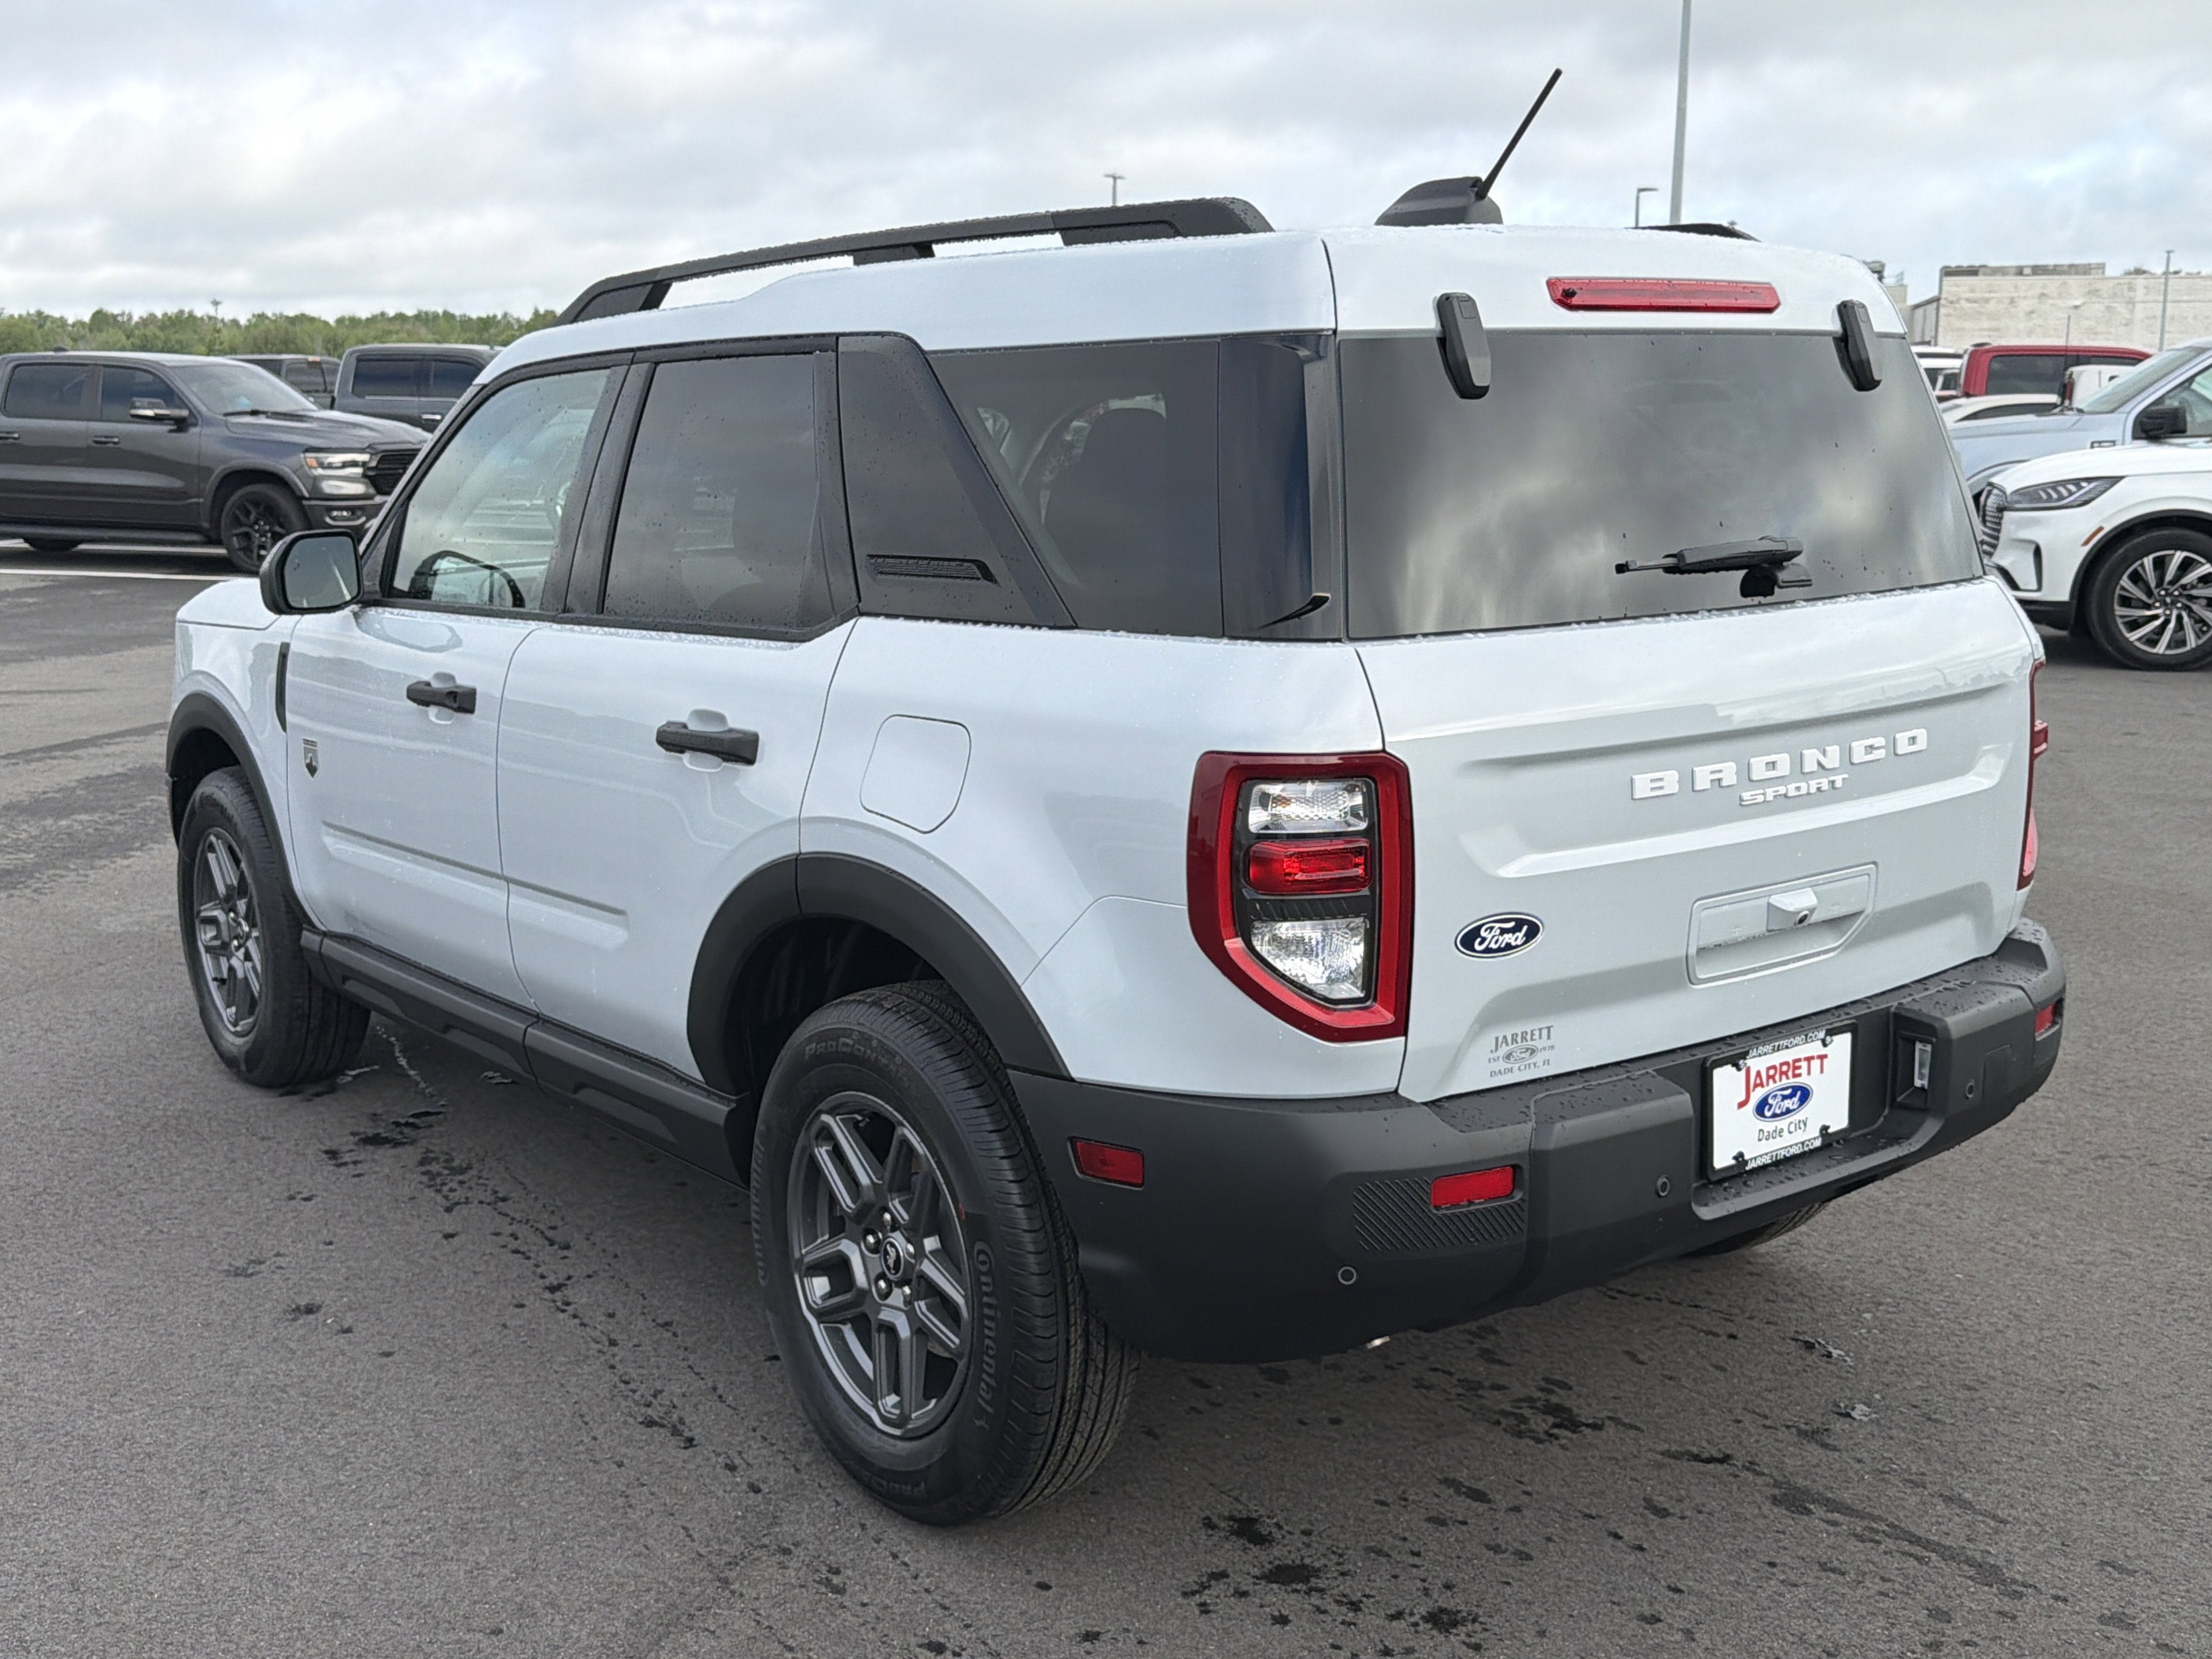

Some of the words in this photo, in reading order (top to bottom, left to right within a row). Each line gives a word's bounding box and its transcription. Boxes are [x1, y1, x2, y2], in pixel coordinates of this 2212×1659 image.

[1632, 728, 1927, 799] BRONCO
[1740, 774, 1848, 806] SPORT
[1474, 922, 1528, 951] Ford
[1490, 1025, 1554, 1054] JARRETT
[1746, 1030, 1826, 1059] JARRETTFORD.COM
[1488, 1056, 1500, 1064] EST
[1490, 1065, 1515, 1077] DADE
[1737, 1054, 1828, 1110] JARRETT
[1764, 1088, 1801, 1117] Ford
[1757, 1126, 1784, 1142] Dade
[1787, 1117, 1808, 1135] City
[1745, 1136, 1822, 1170] JARRETTFORD.COM
[973, 1240, 1002, 1414] Continental
